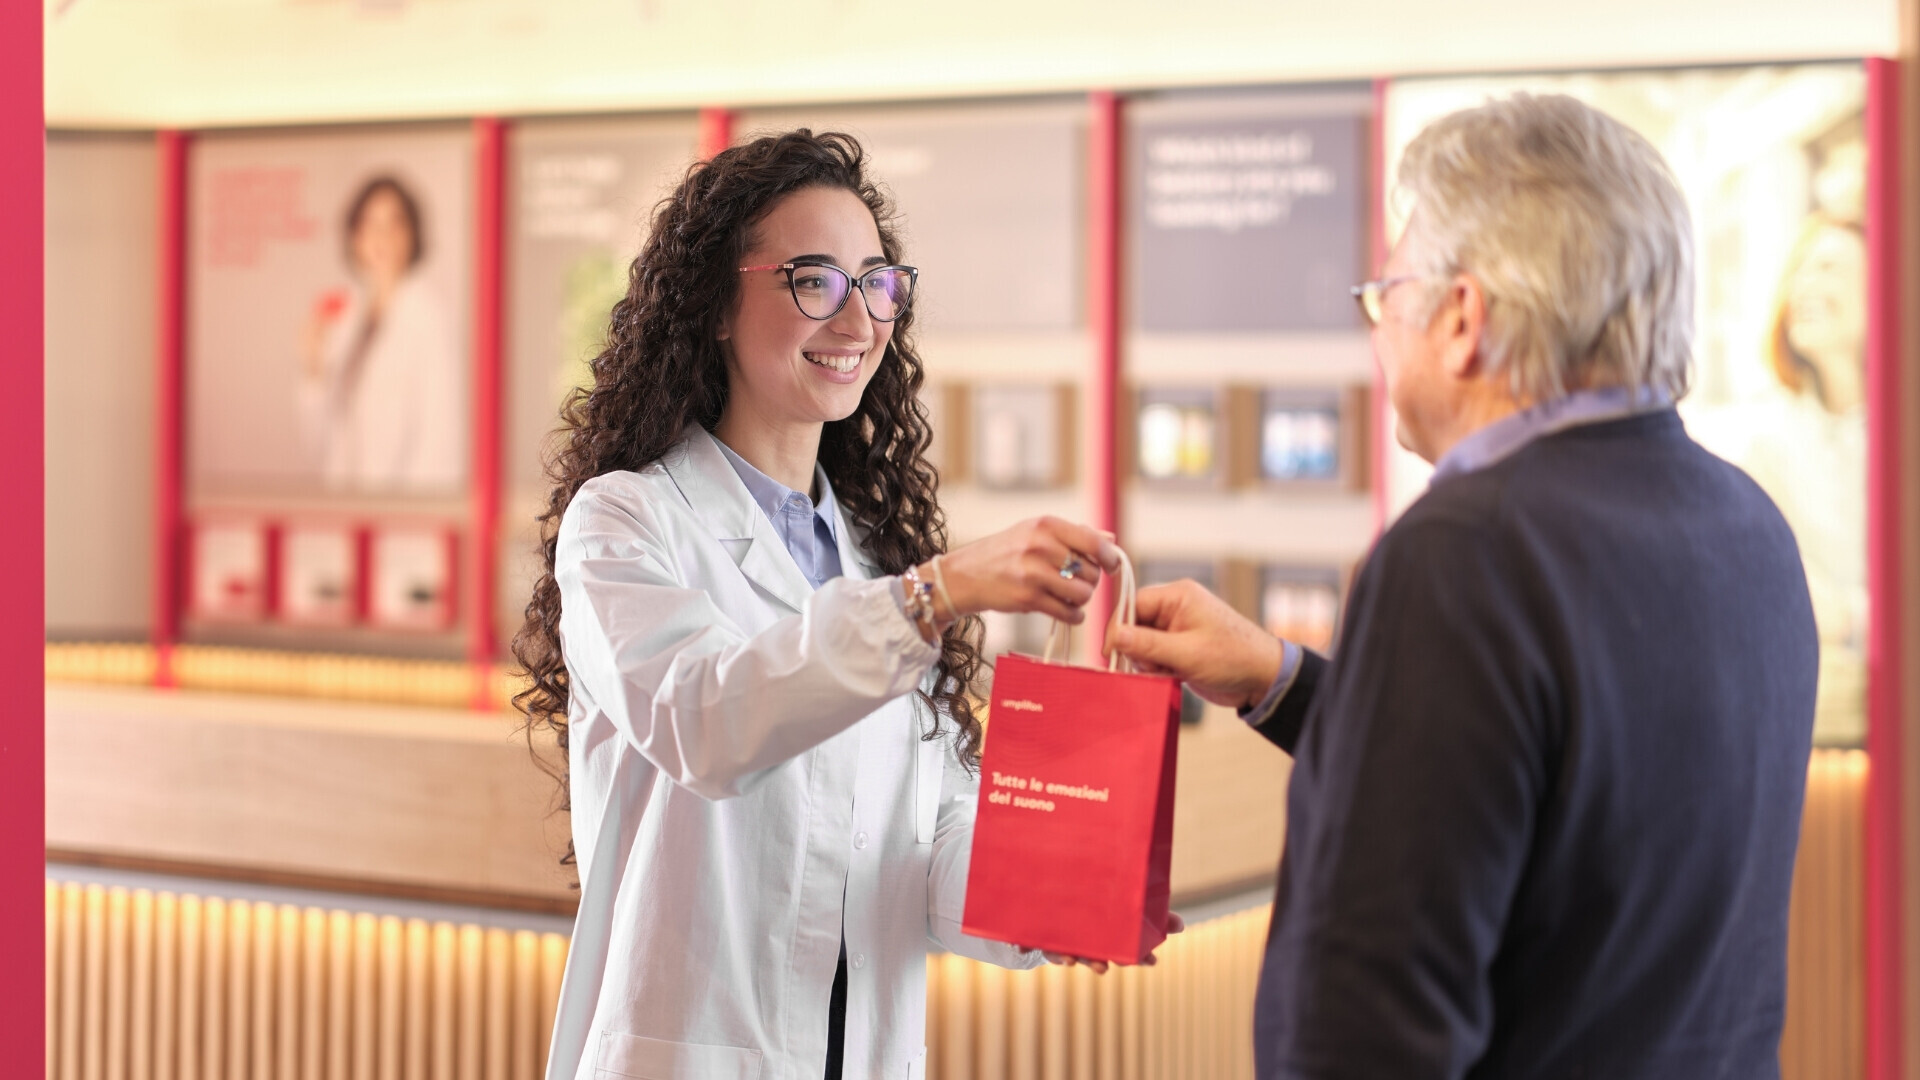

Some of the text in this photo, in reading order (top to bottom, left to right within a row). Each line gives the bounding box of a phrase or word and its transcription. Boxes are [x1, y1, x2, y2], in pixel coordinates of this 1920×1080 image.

[992, 772, 1109, 802] Tutte le emozioni
[988, 790, 1055, 812] del suono
